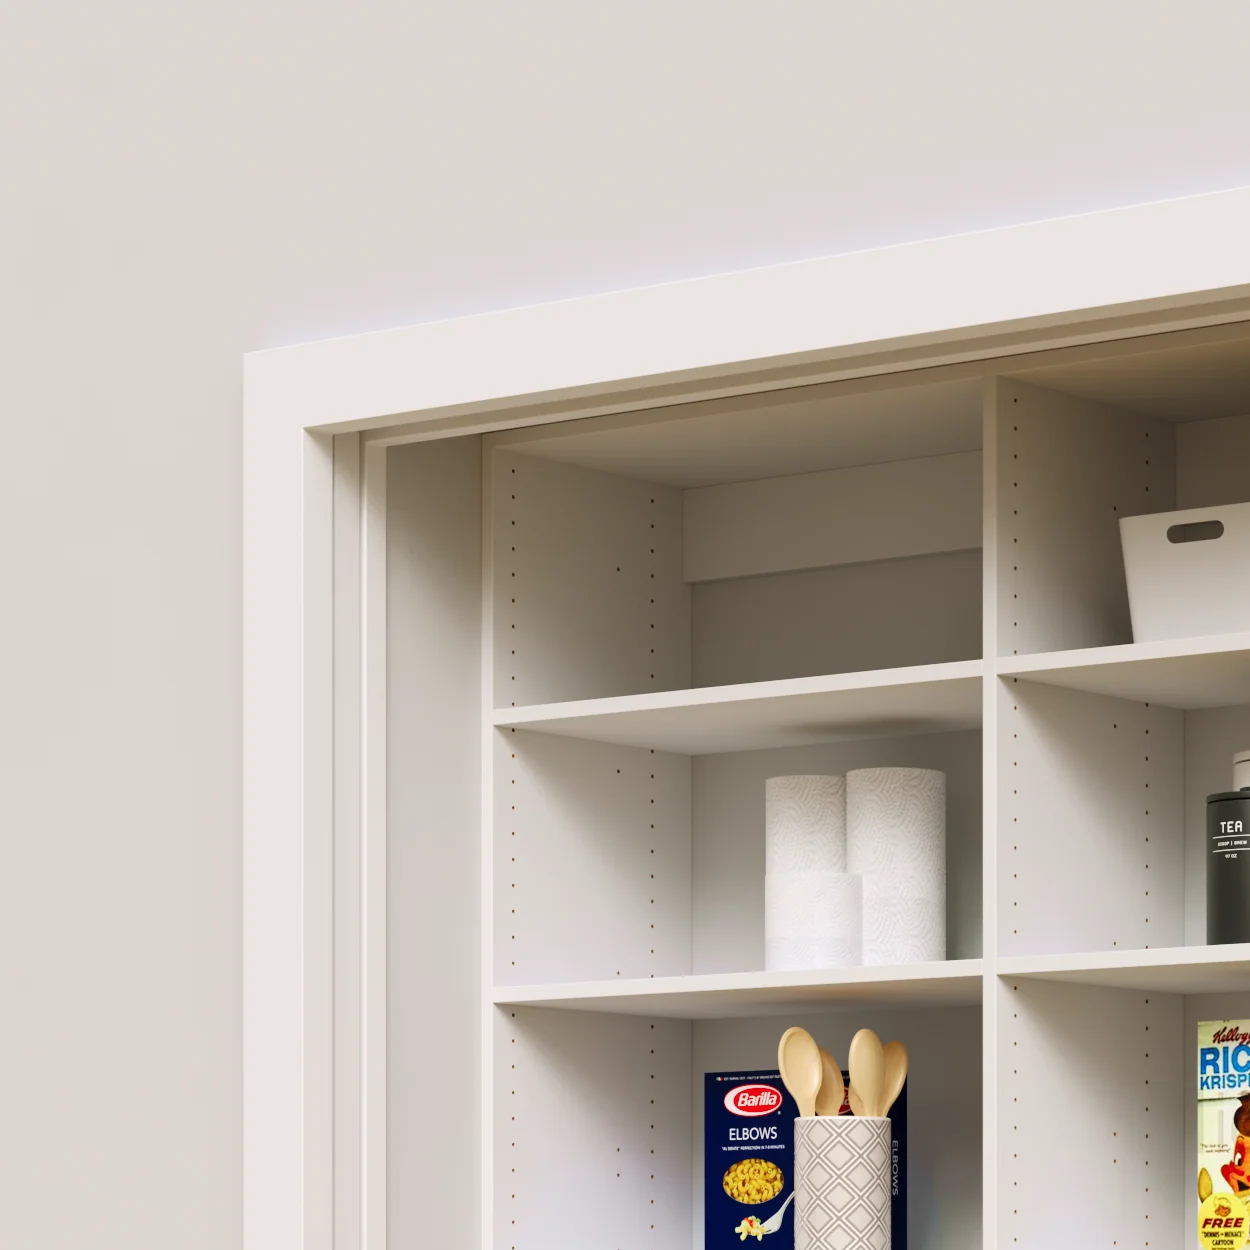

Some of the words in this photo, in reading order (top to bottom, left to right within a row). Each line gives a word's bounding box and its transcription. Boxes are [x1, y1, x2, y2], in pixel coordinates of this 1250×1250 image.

[1220, 820, 1242, 833] TEA
[738, 1091, 778, 1107] Barilla
[729, 1126, 778, 1141] ELBOWS
[1202, 1218, 1244, 1228] FREE
